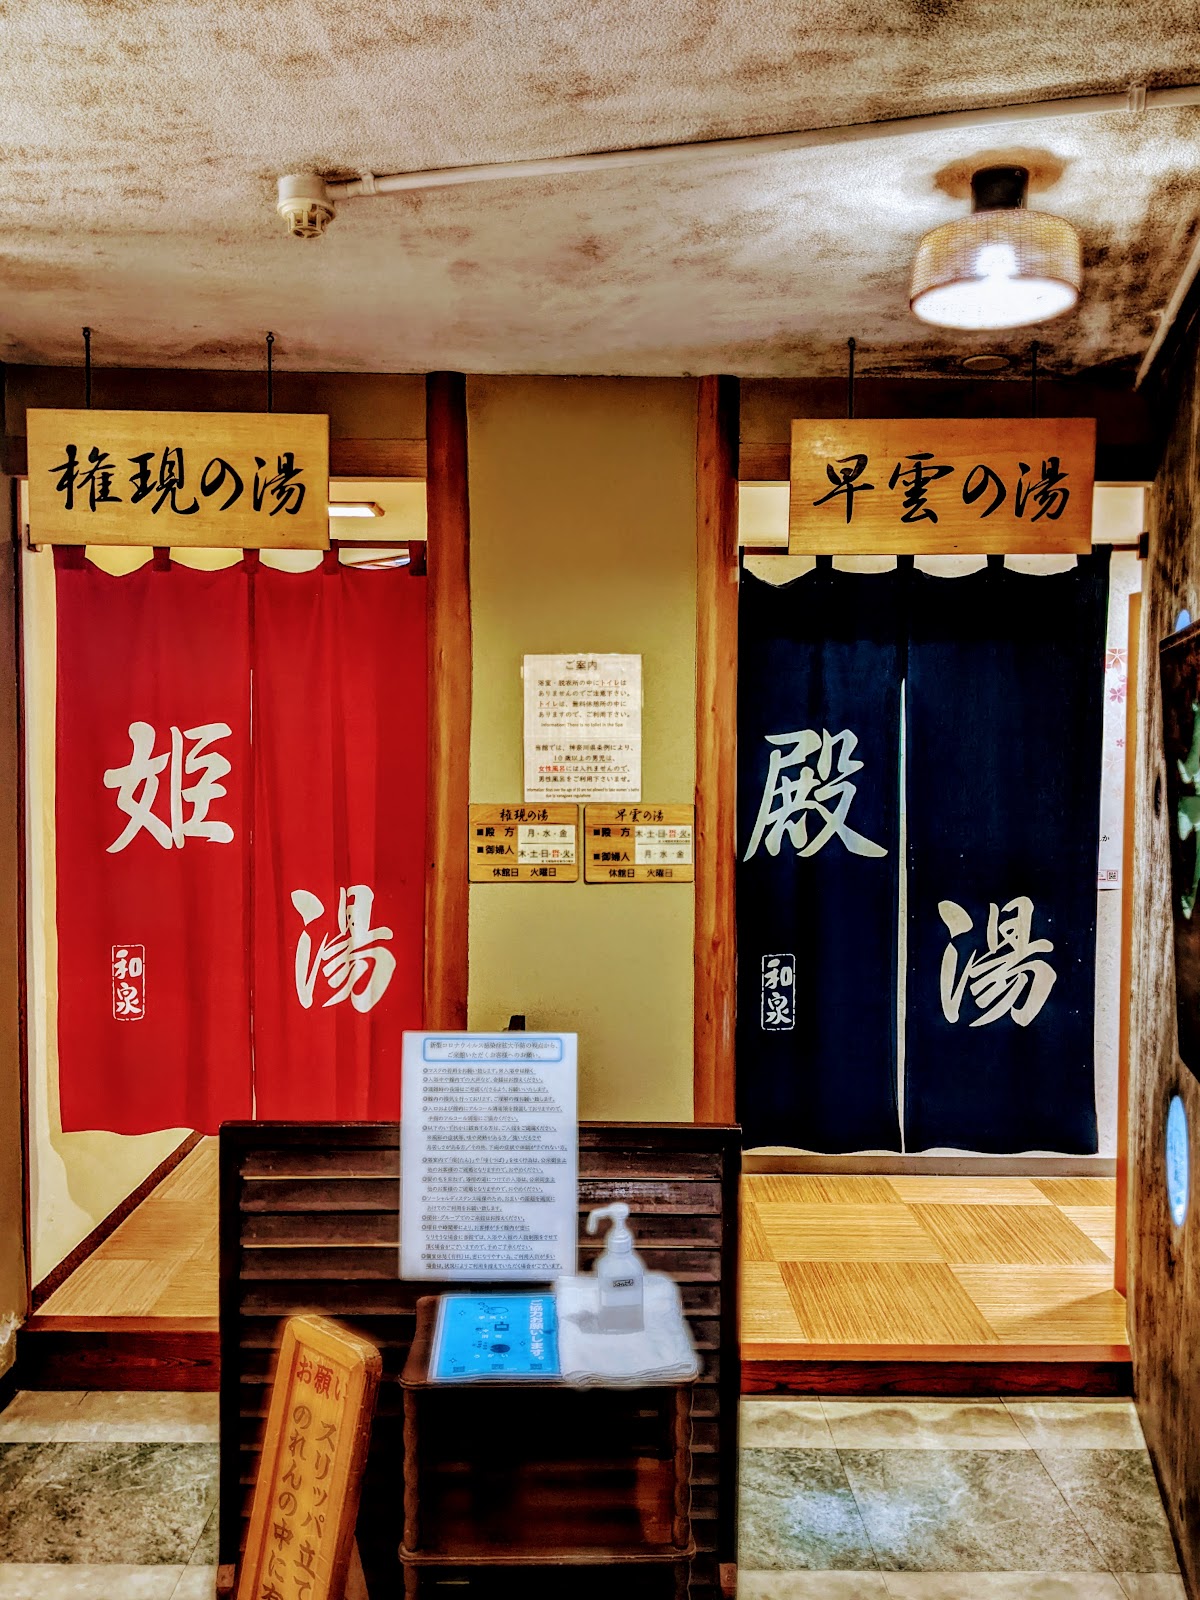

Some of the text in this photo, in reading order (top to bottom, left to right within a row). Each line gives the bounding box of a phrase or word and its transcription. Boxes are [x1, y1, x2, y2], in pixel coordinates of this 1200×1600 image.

[48, 444, 306, 516] 権現の湯
[813, 452, 1070, 524] 早雲の湯
[566, 660, 598, 671] ご案内
[103, 721, 234, 854] 姫
[499, 808, 549, 822] 権現の湯
[615, 808, 664, 822] 早雲の湯
[743, 728, 888, 862] 殿
[485, 845, 514, 855] 御婦人
[493, 868, 556, 877] 休館日 火曜日
[601, 852, 630, 861] 御婦人
[609, 869, 673, 878] 休館日 火曜日
[291, 884, 396, 1013] 湯
[937, 896, 1057, 1027] 湯
[113, 949, 142, 1015] 和泉
[764, 958, 792, 1024] 和泉
[297, 1356, 349, 1401] お願い
